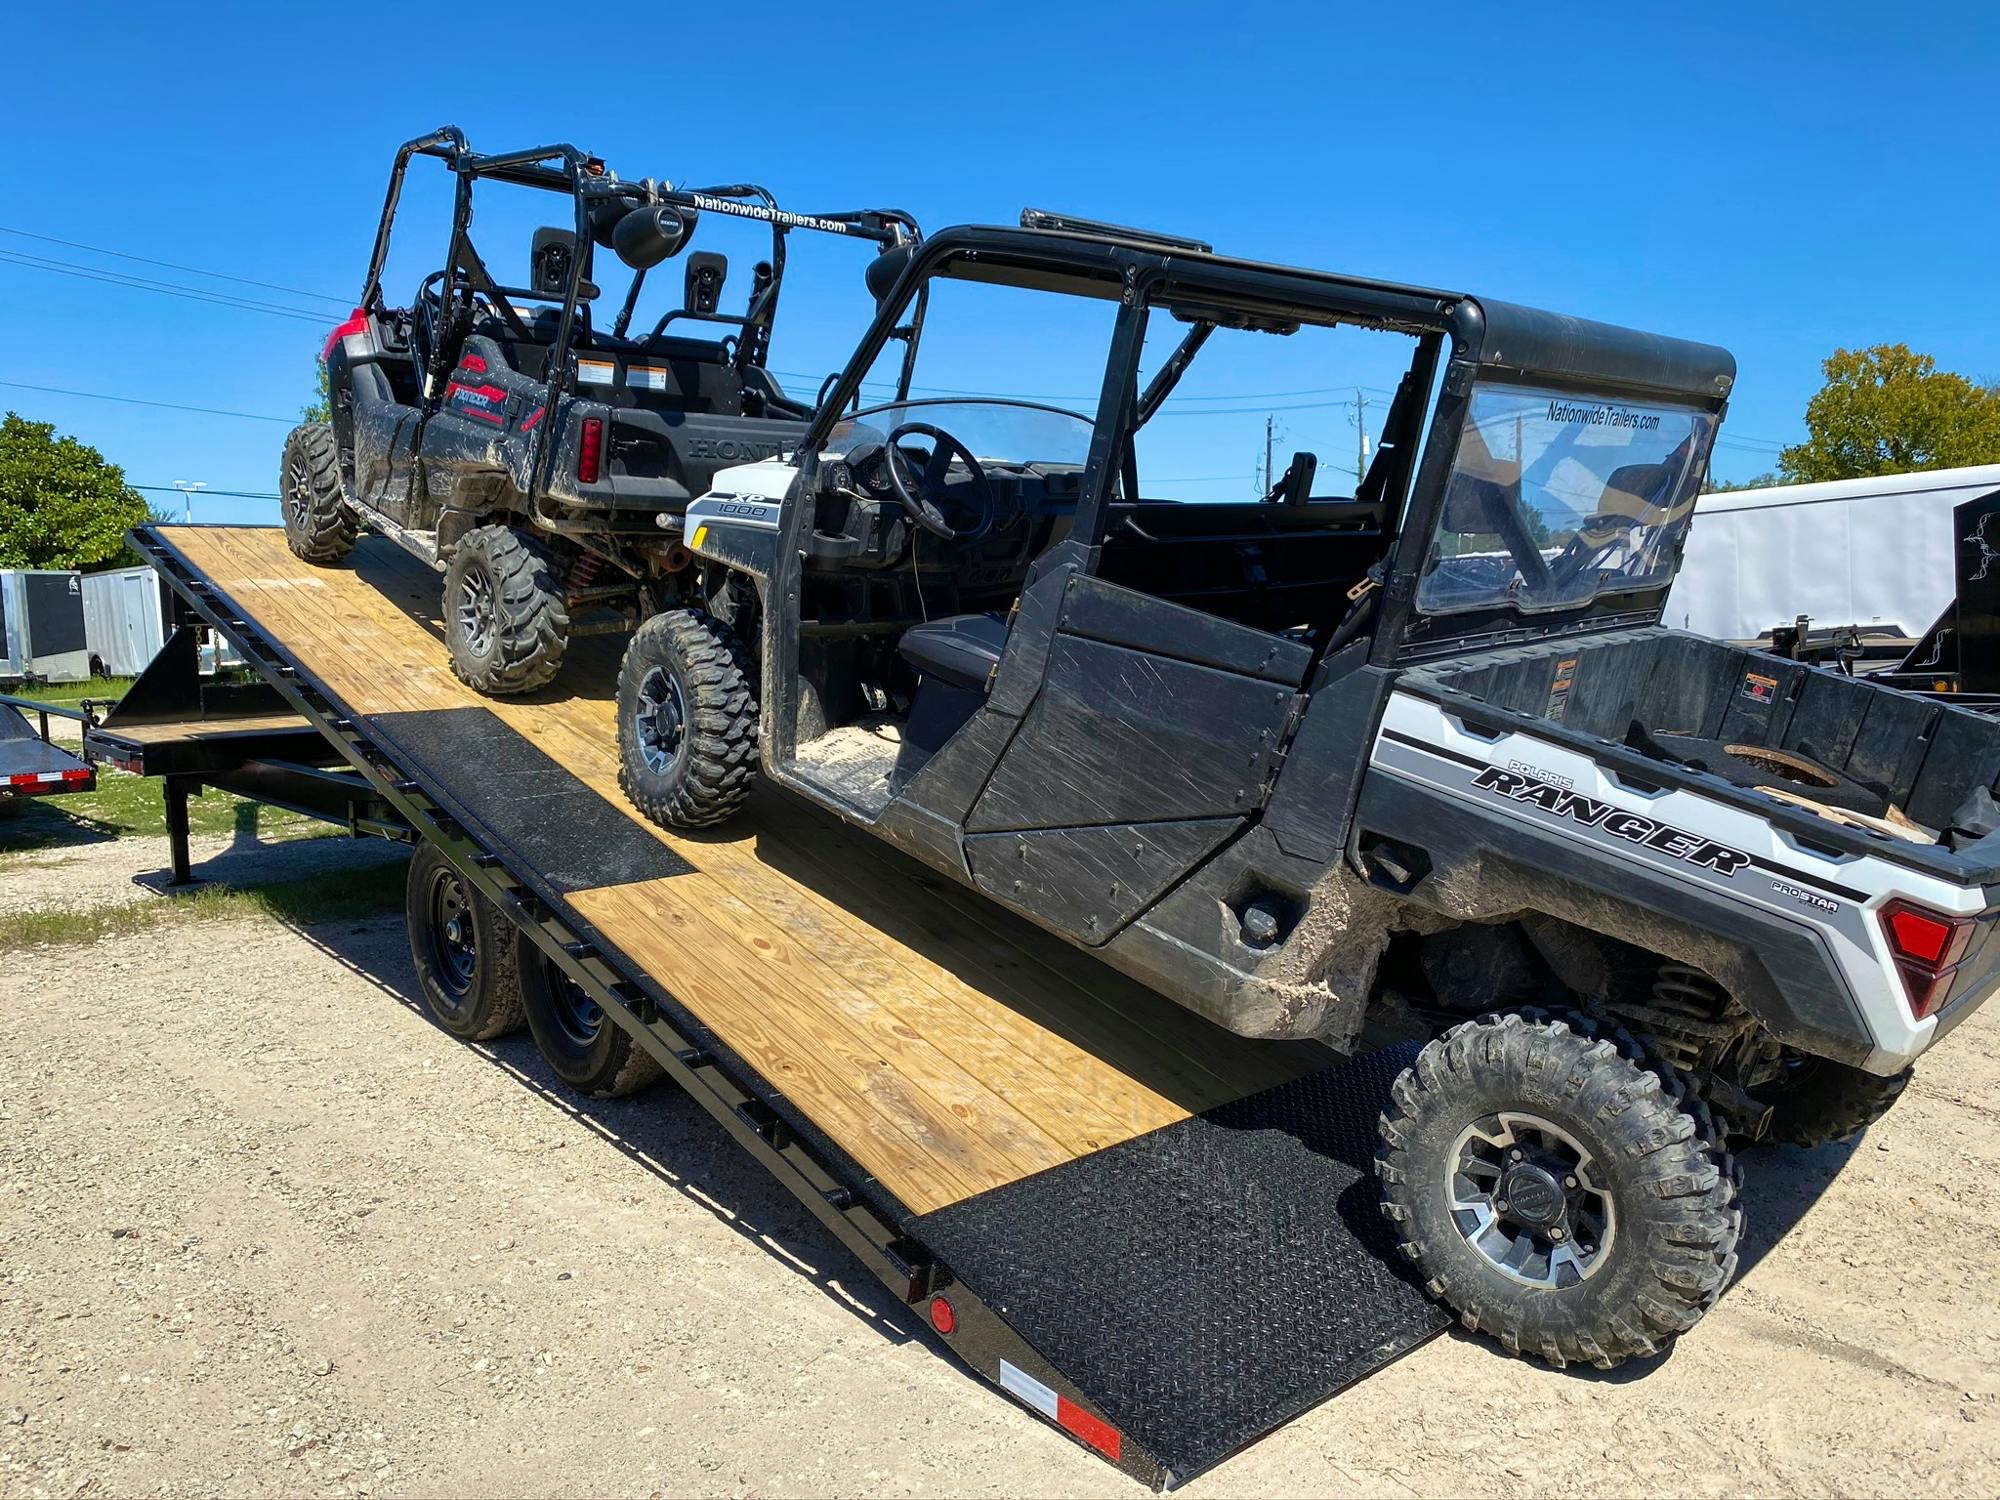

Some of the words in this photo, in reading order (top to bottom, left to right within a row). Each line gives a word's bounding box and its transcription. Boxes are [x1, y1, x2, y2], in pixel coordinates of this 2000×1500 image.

[693, 195, 847, 233] NationwideTrailers.com
[1546, 401, 1660, 431] NationwideTrailers.com
[688, 439, 791, 461] HON
[719, 504, 768, 517] 1000
[730, 492, 766, 503] XP
[1508, 760, 1574, 790] POLARIS
[1471, 766, 1751, 877] RANGER
[1770, 881, 1839, 912] PROSTAR
